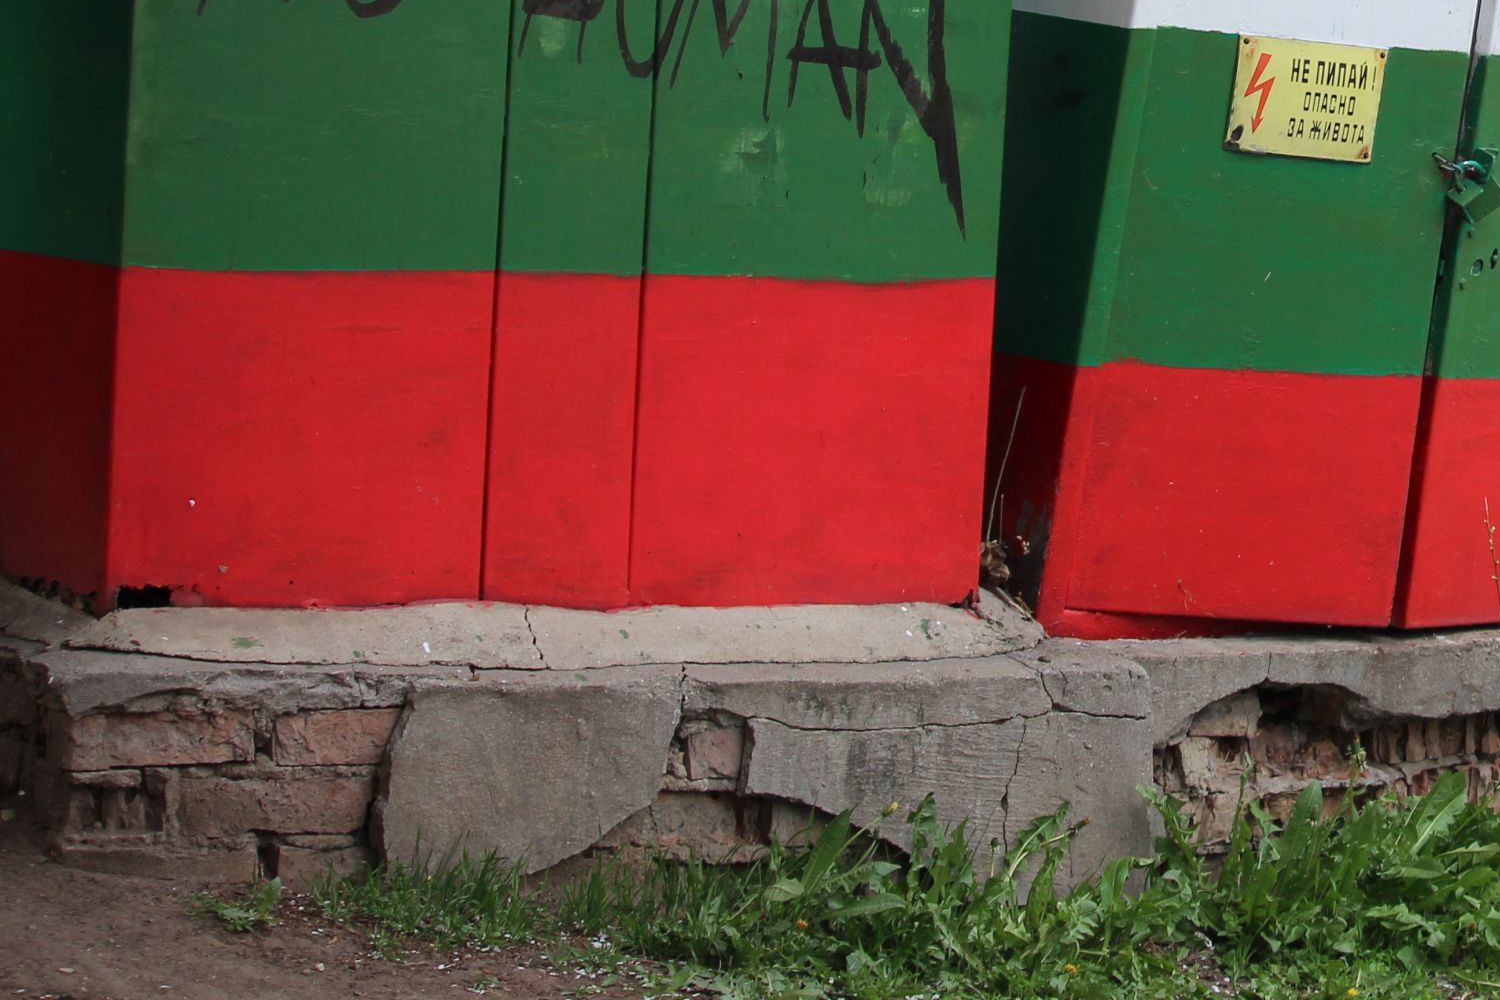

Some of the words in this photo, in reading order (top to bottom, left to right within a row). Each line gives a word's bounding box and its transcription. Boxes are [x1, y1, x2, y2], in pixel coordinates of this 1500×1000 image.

[1290, 58, 1311, 84] НЕ
[1303, 91, 1356, 116] ОПАСНО
[1287, 117, 1304, 138] ЗА
[1308, 120, 1365, 144] ЖИВОТА
